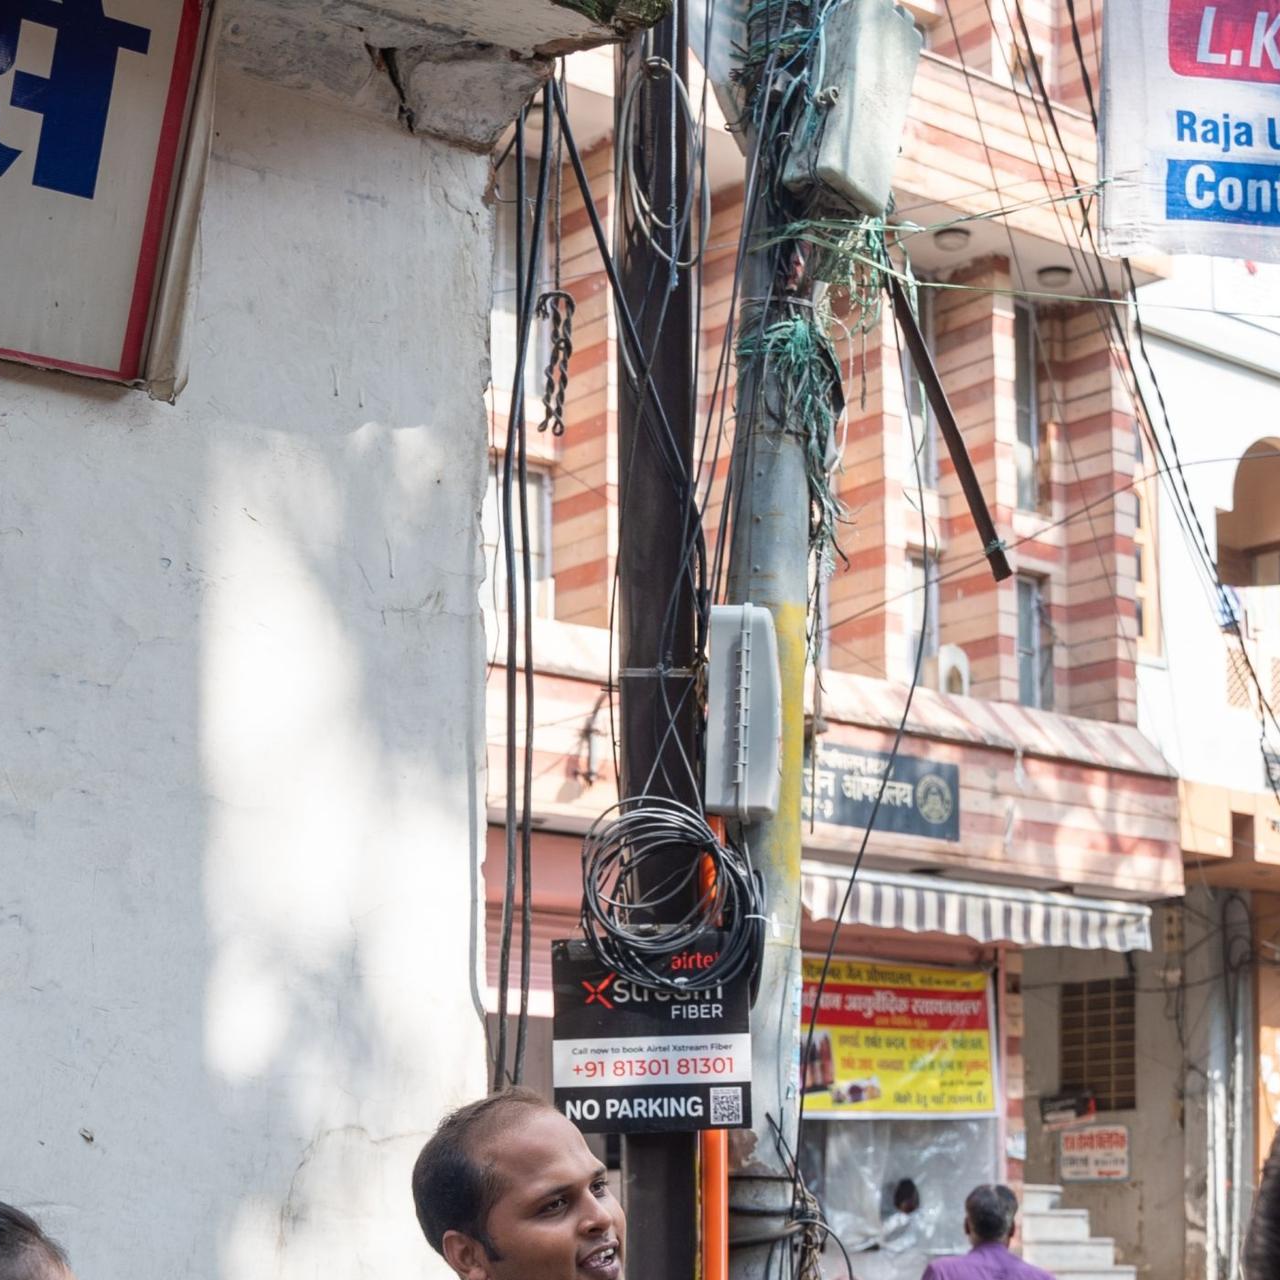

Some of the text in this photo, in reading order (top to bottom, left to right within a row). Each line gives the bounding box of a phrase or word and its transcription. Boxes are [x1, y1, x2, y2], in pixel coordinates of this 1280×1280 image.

[1175, 110, 1253, 153] Raja
[671, 1004, 723, 1019] FIBER
[572, 1047, 589, 1056] Call
[611, 1047, 620, 1055] to
[622, 1045, 643, 1054] book
[646, 1044, 670, 1053] Airtel
[710, 1042, 733, 1051] Fiber
[572, 1057, 734, 1078] +91 81301 81301
[565, 1096, 704, 1121] NO PARKING
